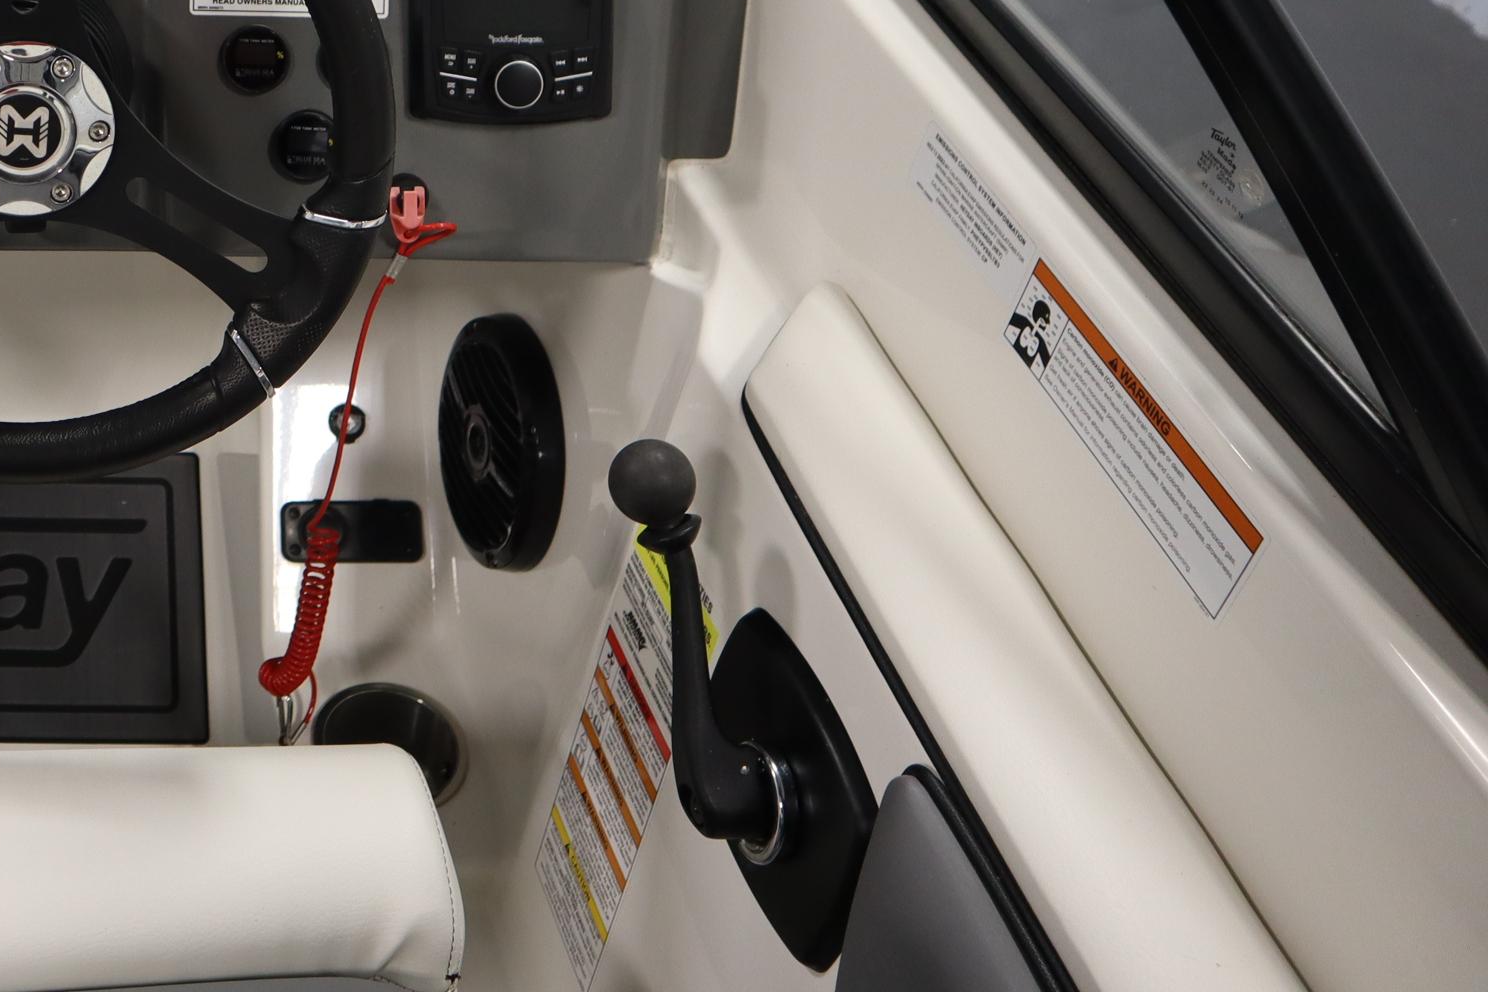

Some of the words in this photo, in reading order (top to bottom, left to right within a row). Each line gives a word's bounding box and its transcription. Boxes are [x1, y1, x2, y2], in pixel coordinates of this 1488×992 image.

[1211, 127, 1236, 150] Taylor
[935, 132, 958, 162] EMISSIONS
[957, 159, 978, 187] CONTROL
[977, 184, 996, 209] SYSTEM
[995, 205, 1026, 246] INFORMATION
[1067, 327, 1083, 349] Carbon
[1082, 346, 1105, 377] monoxide
[1118, 366, 1172, 437] WARNING
[570, 851, 591, 903] CAUTION
